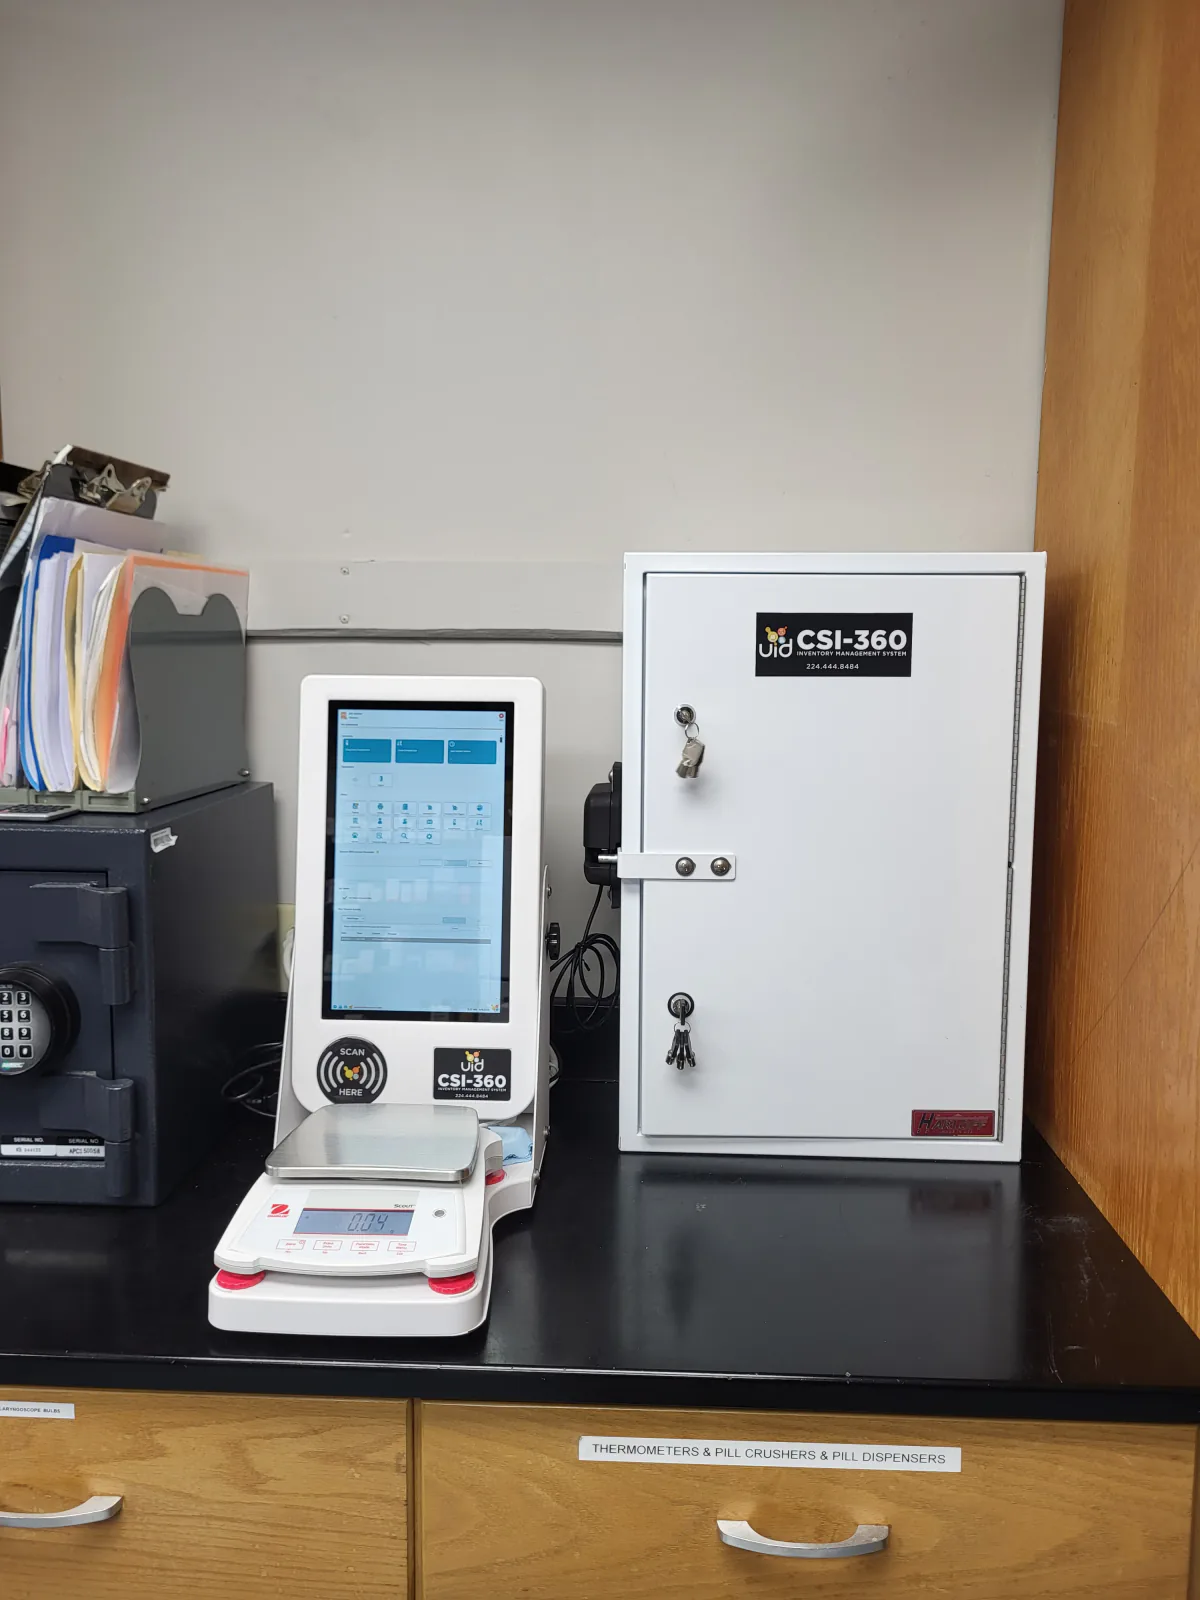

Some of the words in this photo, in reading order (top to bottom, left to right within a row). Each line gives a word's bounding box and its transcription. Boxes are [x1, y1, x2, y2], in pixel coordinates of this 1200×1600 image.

[796, 629, 908, 650] CSI-360
[2, 992, 9, 1001] 2
[20, 992, 27, 1001] 3
[3, 1010, 9, 1019] 5
[20, 1010, 27, 1019] 6
[3, 1028, 10, 1037] 8
[21, 1028, 28, 1037] 9
[339, 1048, 366, 1056] SCAN
[437, 1073, 507, 1088] CSI-360
[338, 1088, 364, 1097] HERE
[347, 1213, 389, 1232] 0.04
[591, 1443, 699, 1457] THERMOMETERS
[702, 1447, 711, 1457] &
[715, 1448, 741, 1458] PILL
[744, 1448, 816, 1461] CRUSHERS
[819, 1451, 829, 1461] &
[832, 1451, 858, 1462] PILL
[862, 1452, 946, 1464] DISPENSERS
